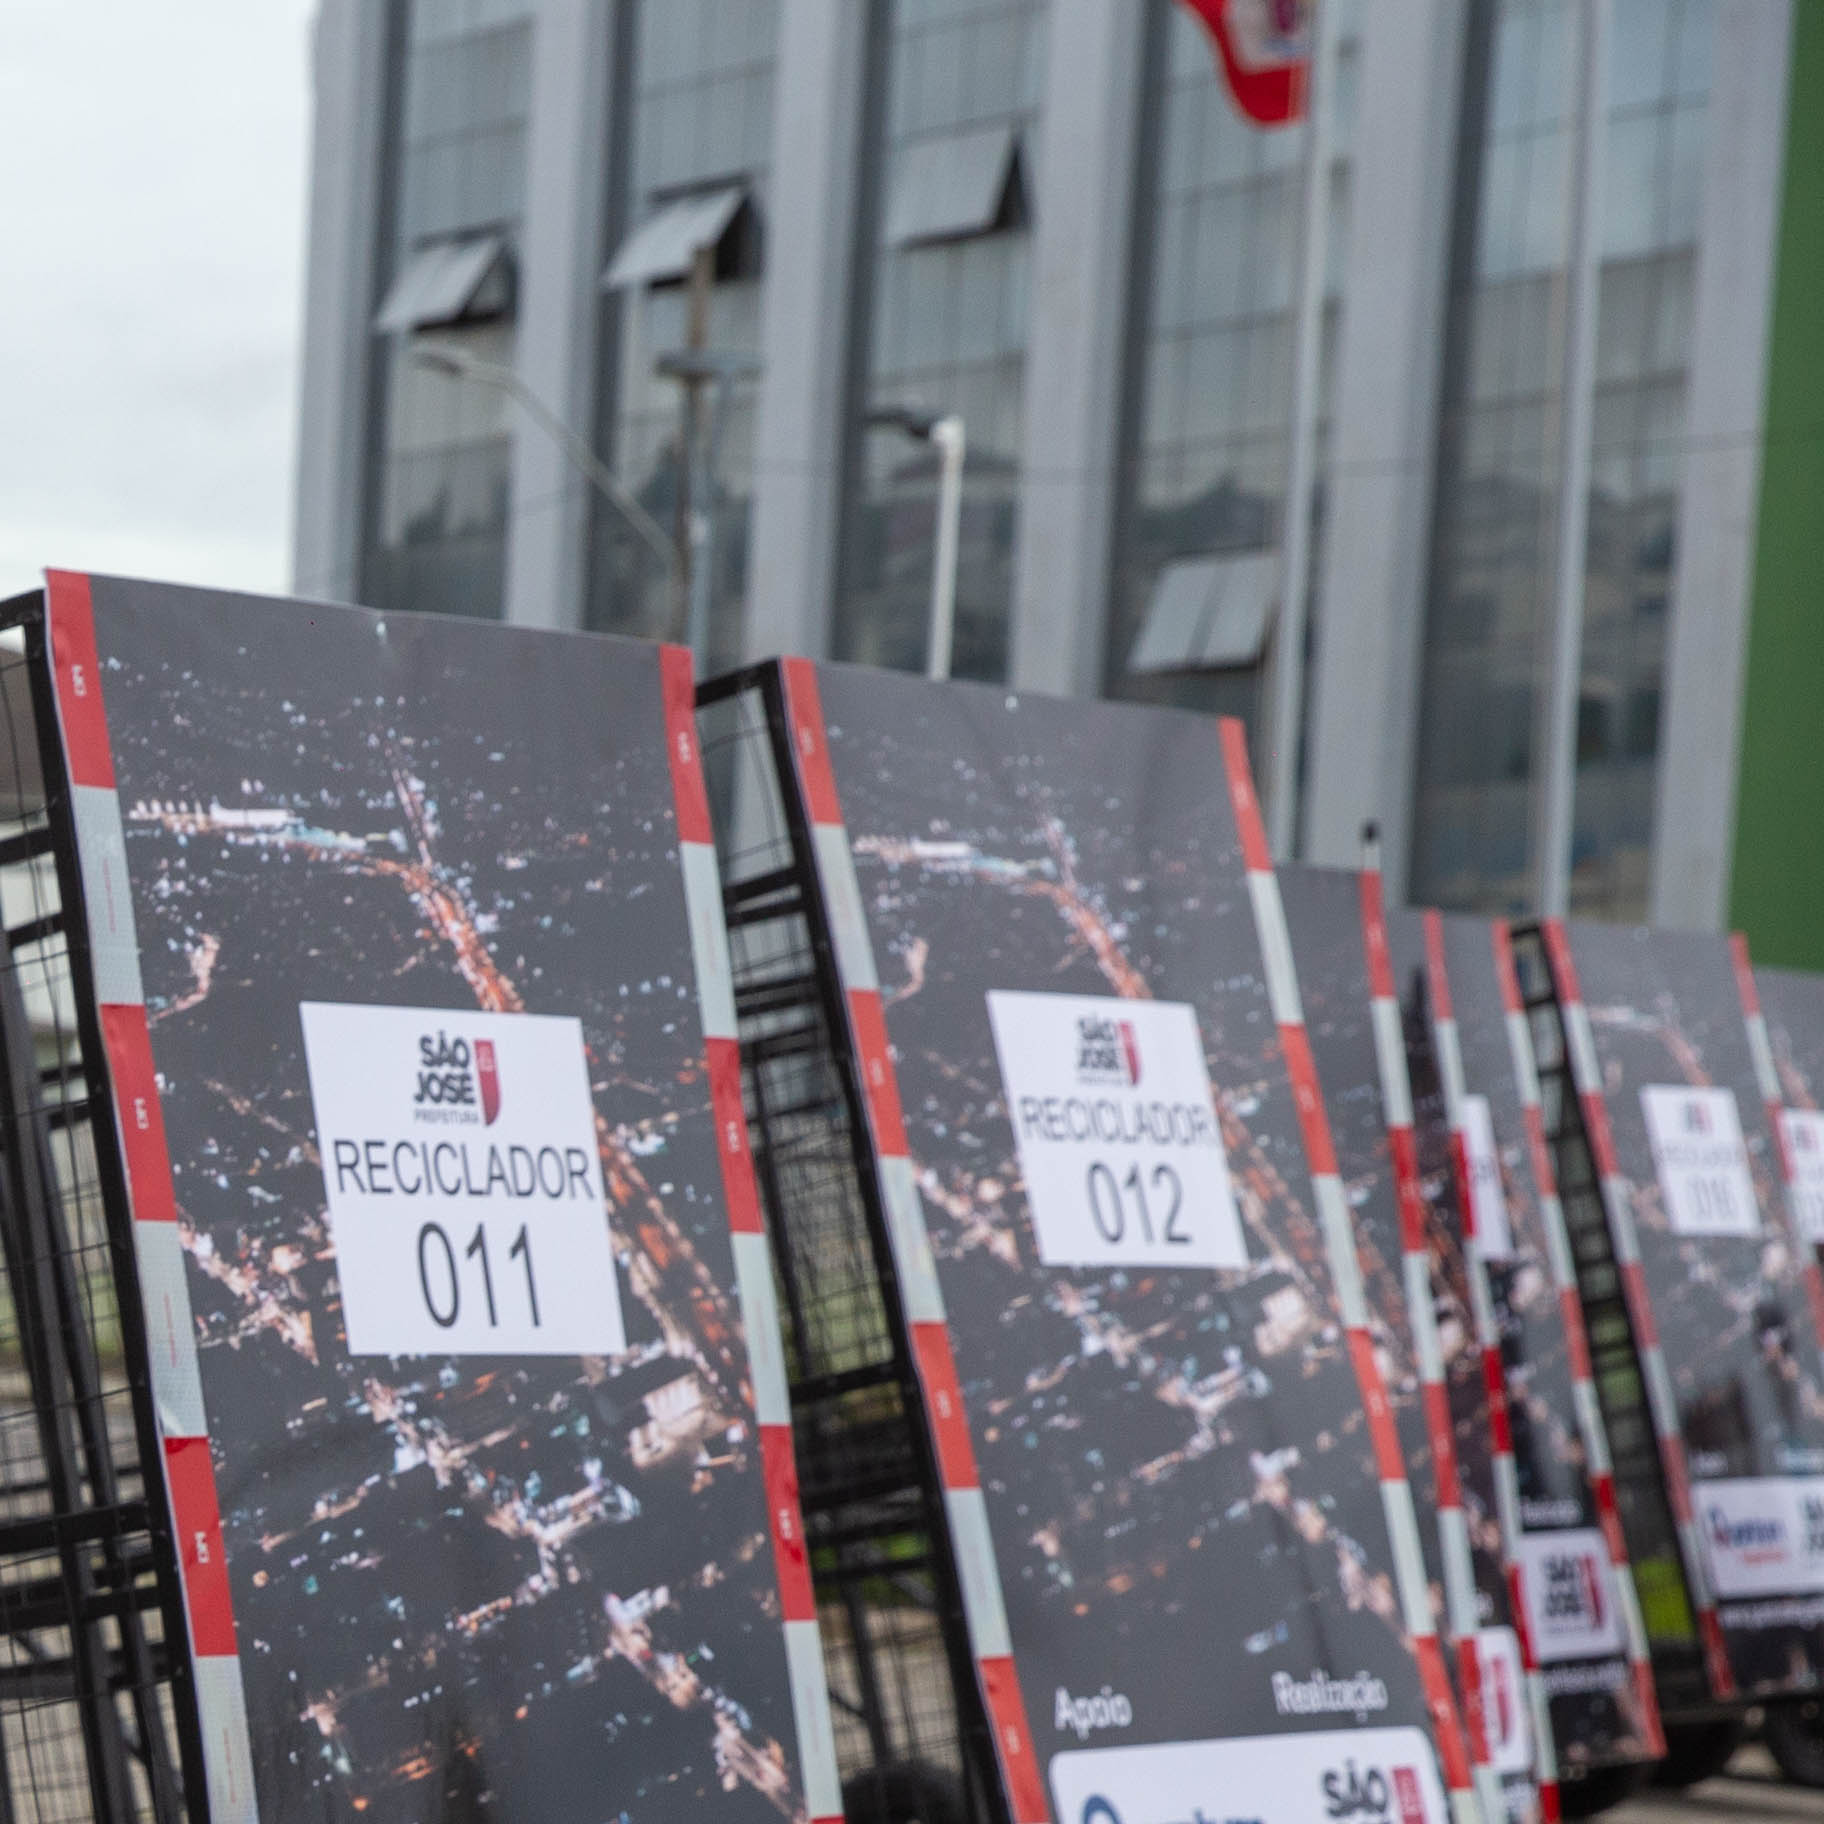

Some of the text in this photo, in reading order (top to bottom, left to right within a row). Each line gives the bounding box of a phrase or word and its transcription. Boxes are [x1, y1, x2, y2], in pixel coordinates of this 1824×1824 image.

[1019, 1097, 1214, 1146] RECICLADOR
[334, 1140, 594, 1199] RECICLADOR
[1088, 1162, 1191, 1244] 012
[418, 1223, 539, 1328] 011
[1056, 1688, 1131, 1736] Apoio
